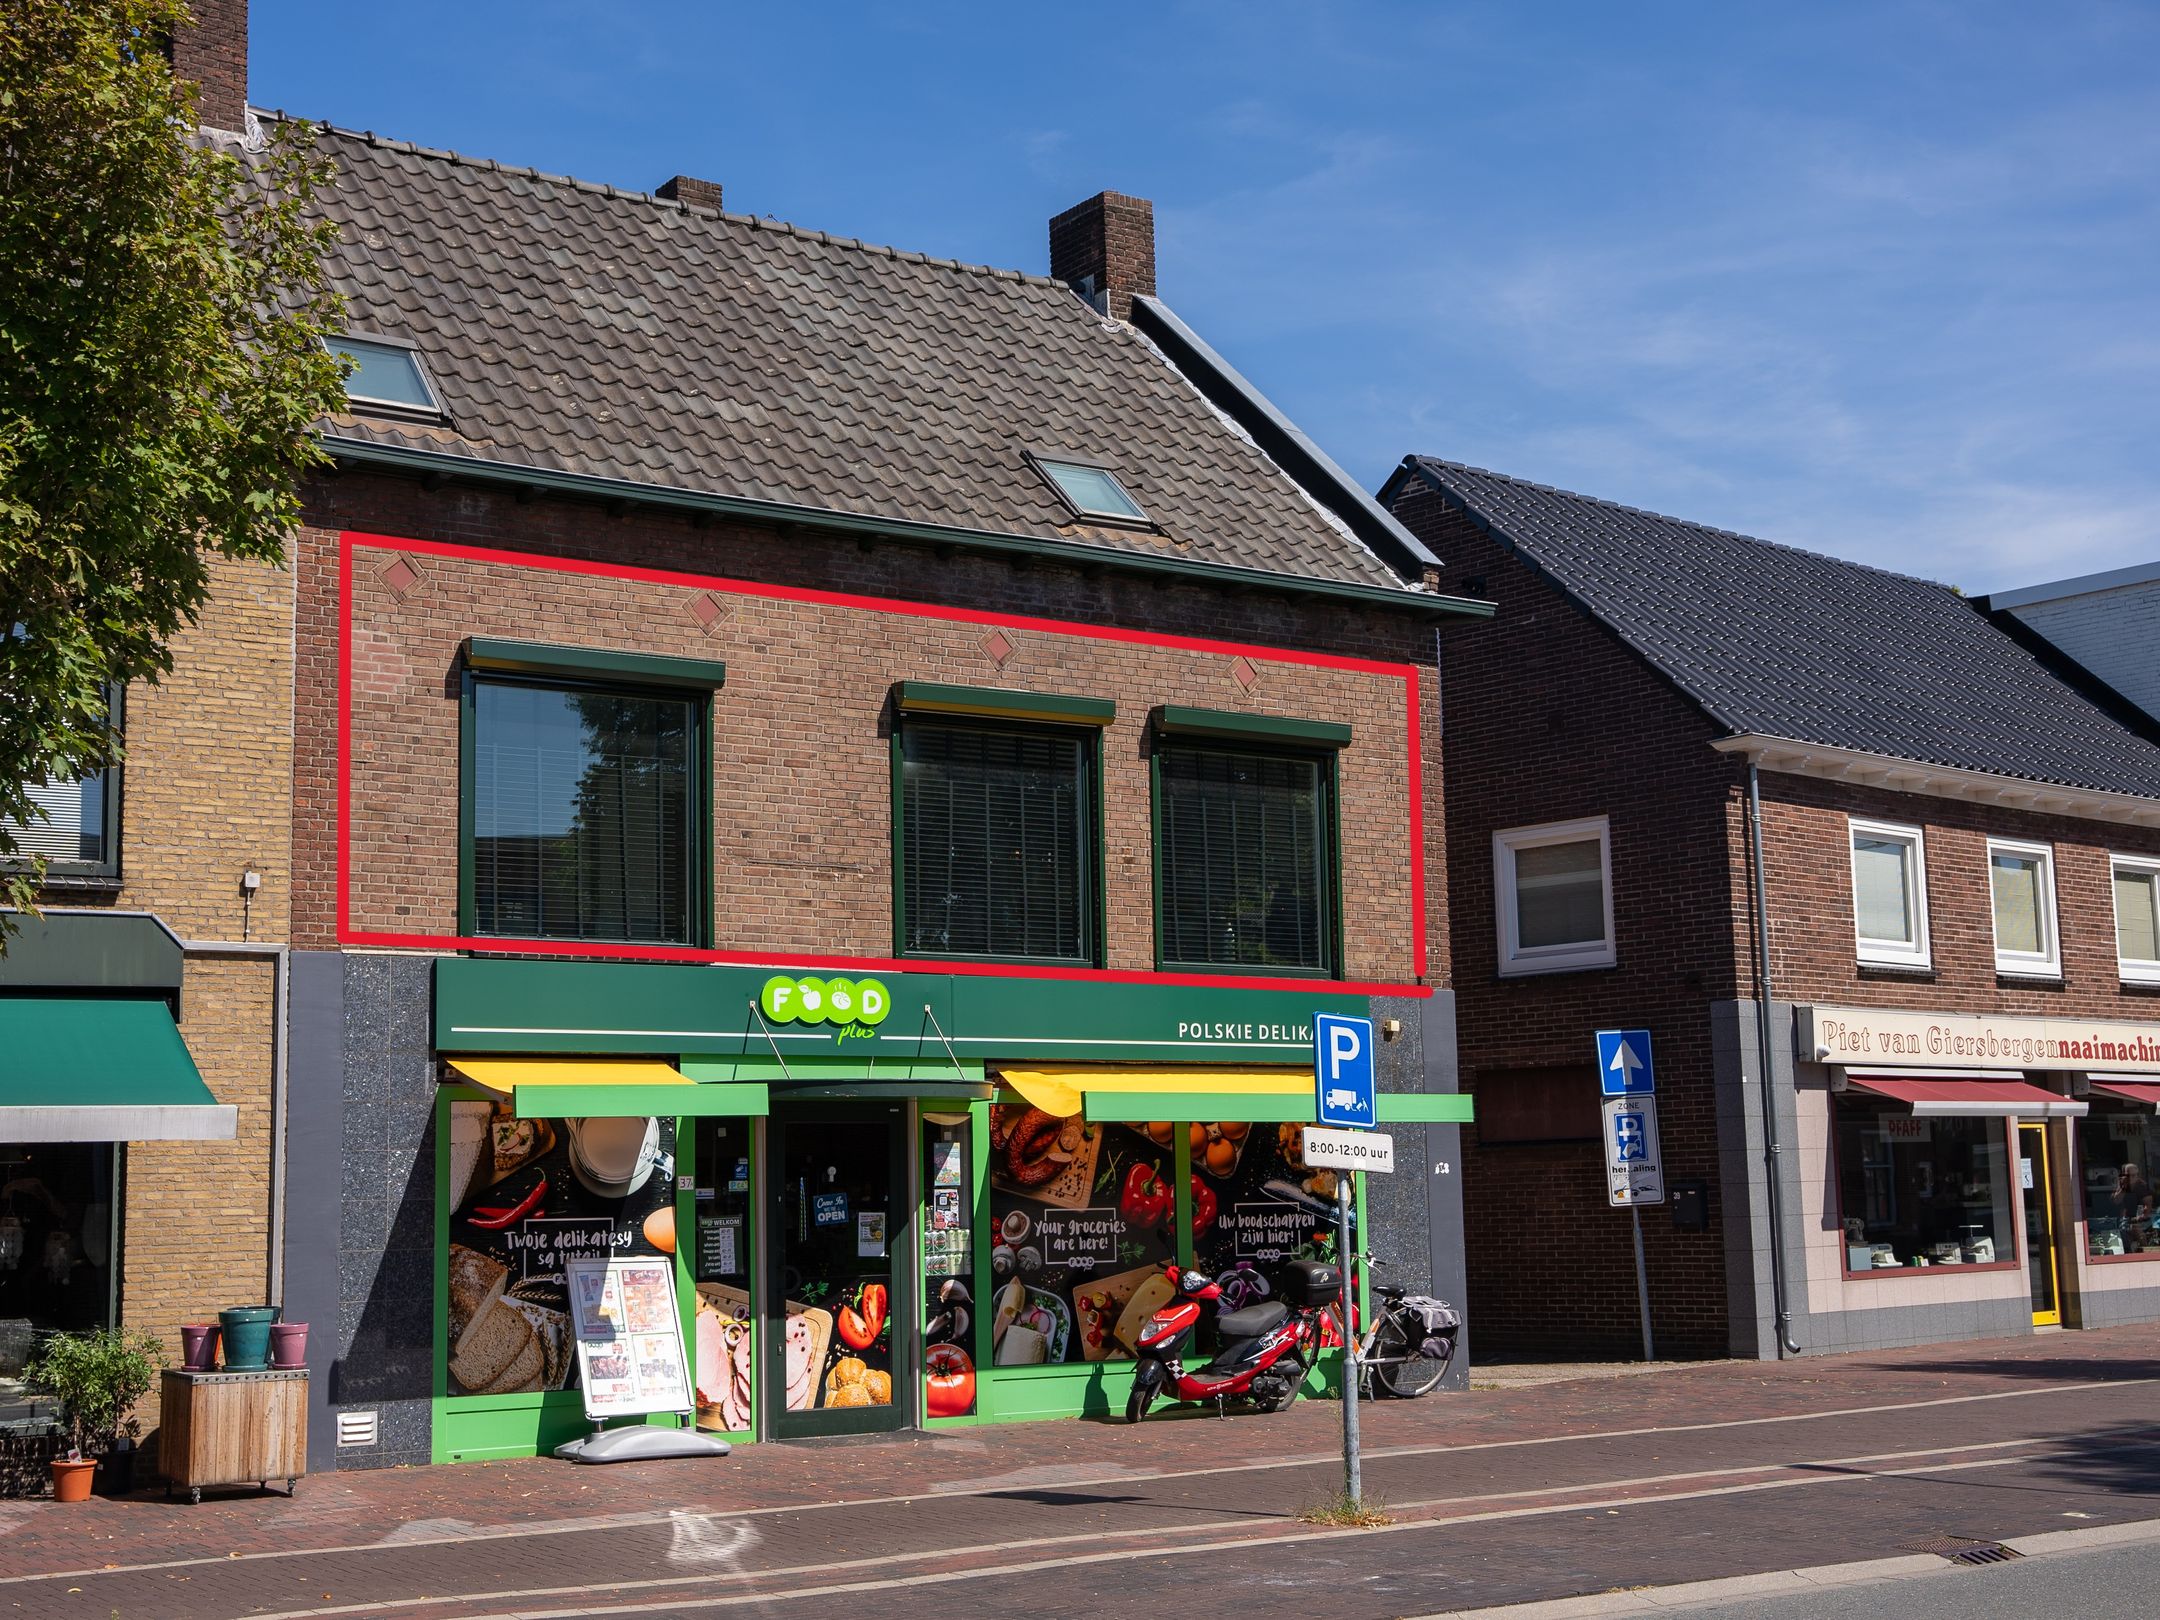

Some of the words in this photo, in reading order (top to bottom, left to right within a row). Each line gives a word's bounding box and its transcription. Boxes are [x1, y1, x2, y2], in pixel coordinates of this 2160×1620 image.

[772, 982, 884, 1016] FOOD
[837, 1024, 876, 1046] plus
[1179, 1022, 1252, 1040] POLSKIE
[1258, 1024, 1314, 1041] DELIK
[1822, 1020, 1871, 1052] Piet
[1878, 1032, 1921, 1054] van
[1926, 1025, 2060, 1063] Giersbergen
[1329, 1025, 1361, 1080] P
[1617, 1102, 1640, 1110] ZONE
[1888, 1119, 1922, 1137] PFAFF
[1310, 1141, 1367, 1158] 8:00-12:00
[1370, 1148, 1388, 1159] uur
[1611, 1164, 1657, 1174] heraling
[680, 1177, 693, 1189] 37
[713, 1218, 740, 1227] WELKOM
[817, 1209, 846, 1222] OPEN
[1218, 1213, 1236, 1230] Uw
[1237, 1212, 1316, 1230] boodschappen
[1068, 1218, 1127, 1236] groceries
[504, 1230, 548, 1250] Twoje
[553, 1229, 633, 1249] delikatesy
[1053, 1238, 1075, 1251] are
[1079, 1236, 1108, 1250] here!
[1241, 1229, 1264, 1245] zijn
[1267, 1228, 1294, 1244] hier!
[537, 1251, 555, 1269] są
